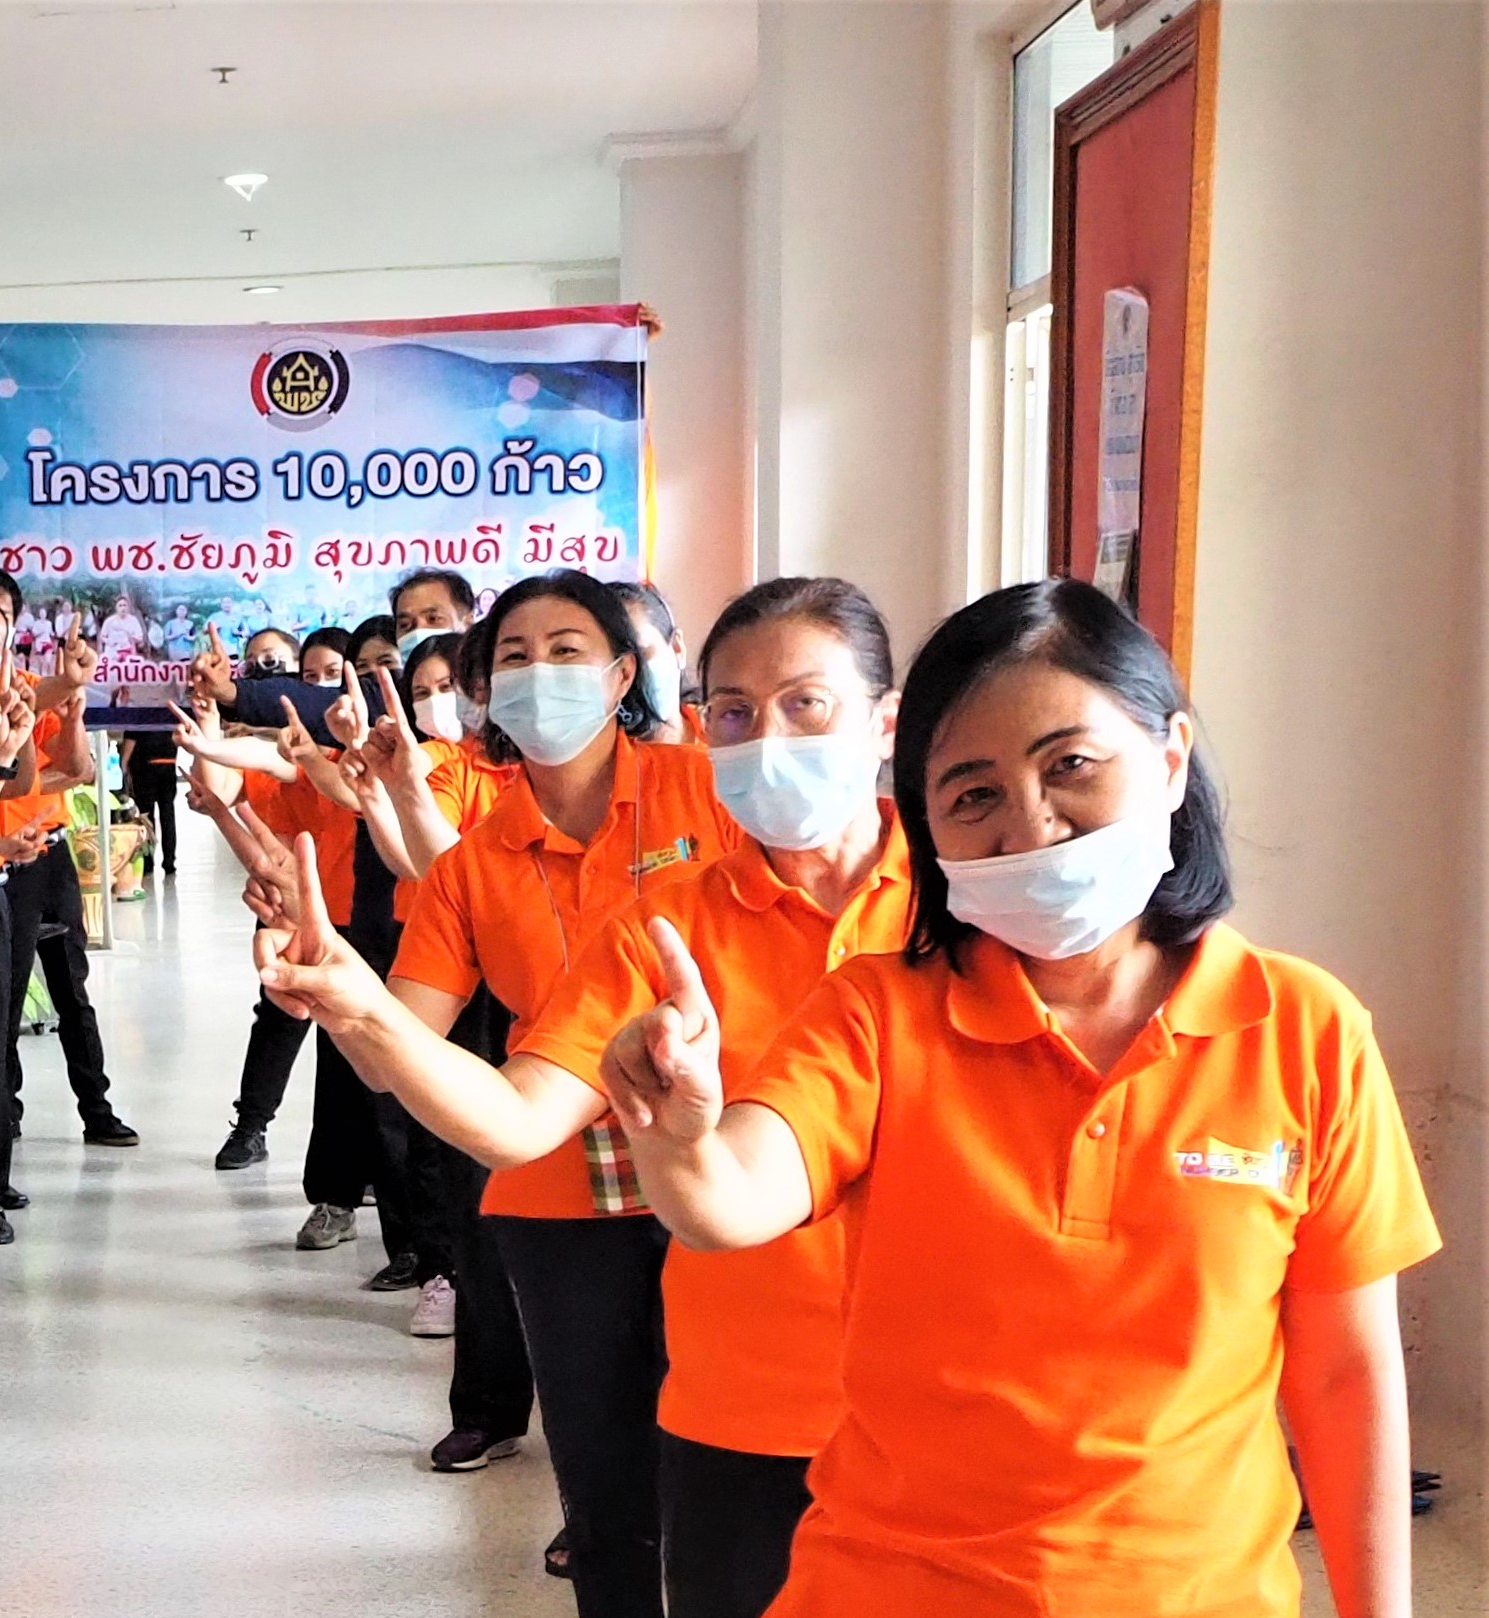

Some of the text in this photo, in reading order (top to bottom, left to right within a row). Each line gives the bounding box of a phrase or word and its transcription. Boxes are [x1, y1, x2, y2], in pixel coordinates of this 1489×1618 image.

[26, 435, 605, 507] โครงการ 10,000 ก้าว
[0, 543, 74, 574] ชาว
[91, 531, 293, 585] พช.ชัยภูมิ
[314, 524, 503, 584] สุขภาพดี
